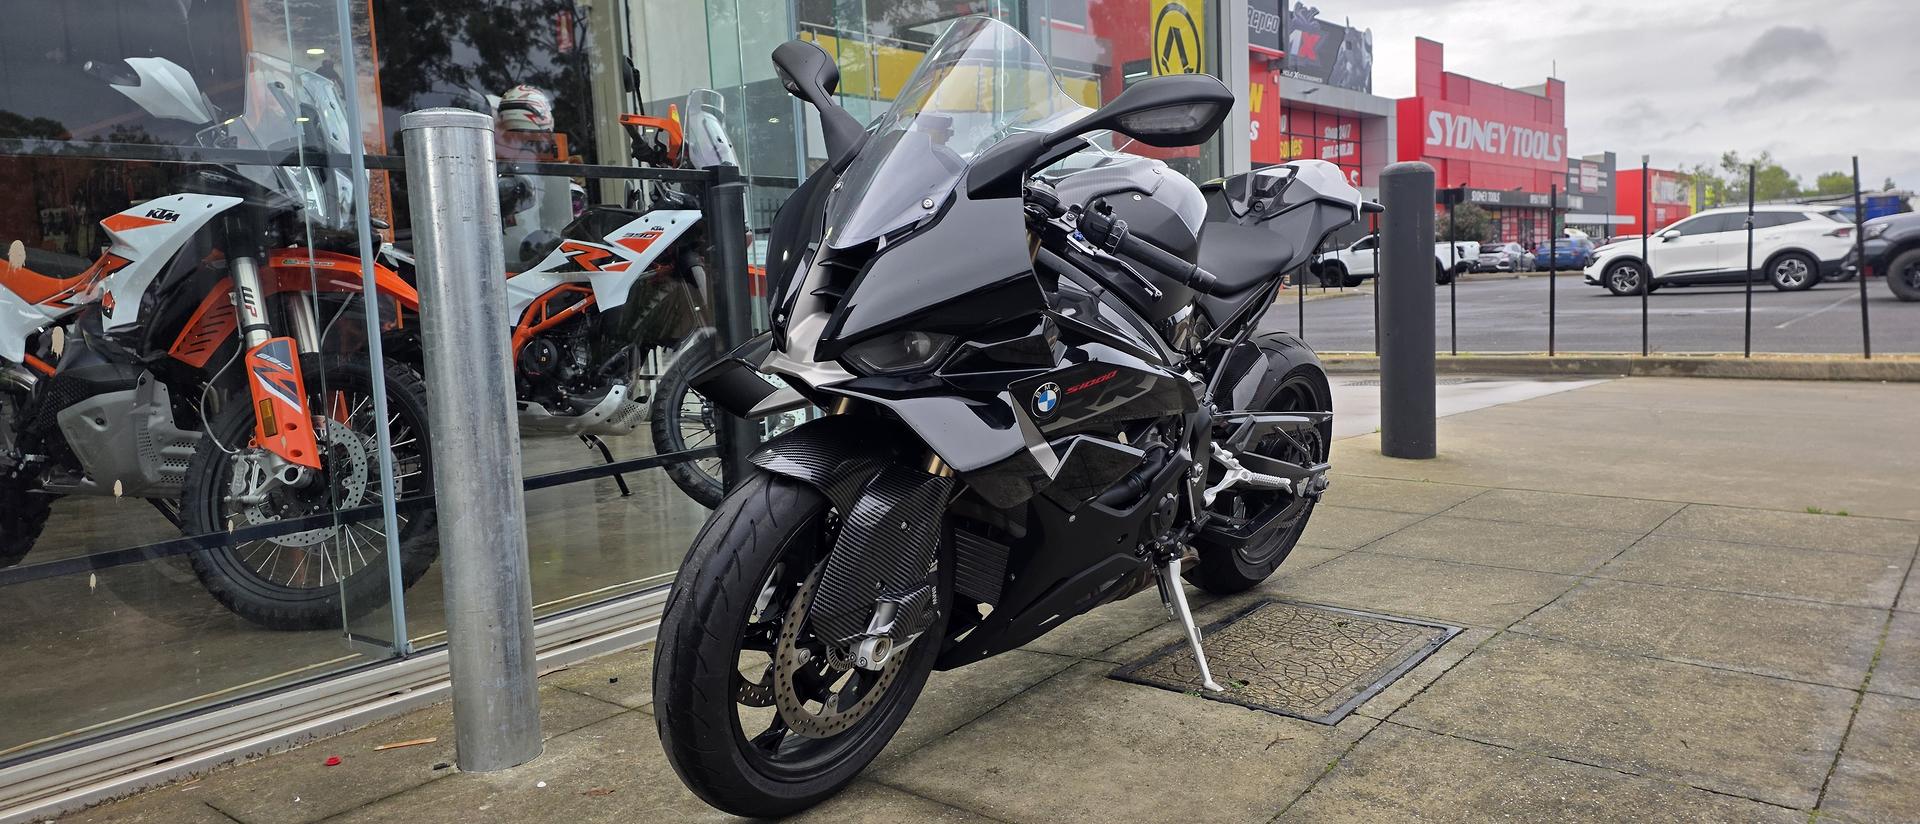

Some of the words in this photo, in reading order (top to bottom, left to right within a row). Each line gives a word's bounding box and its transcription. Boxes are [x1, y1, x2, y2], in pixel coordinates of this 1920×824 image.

[1426, 110, 1511, 155] SYDNEY
[1512, 126, 1563, 162] TOOLS
[145, 207, 180, 222] KTM
[241, 285, 258, 319] WP
[1065, 369, 1120, 395] S1000
